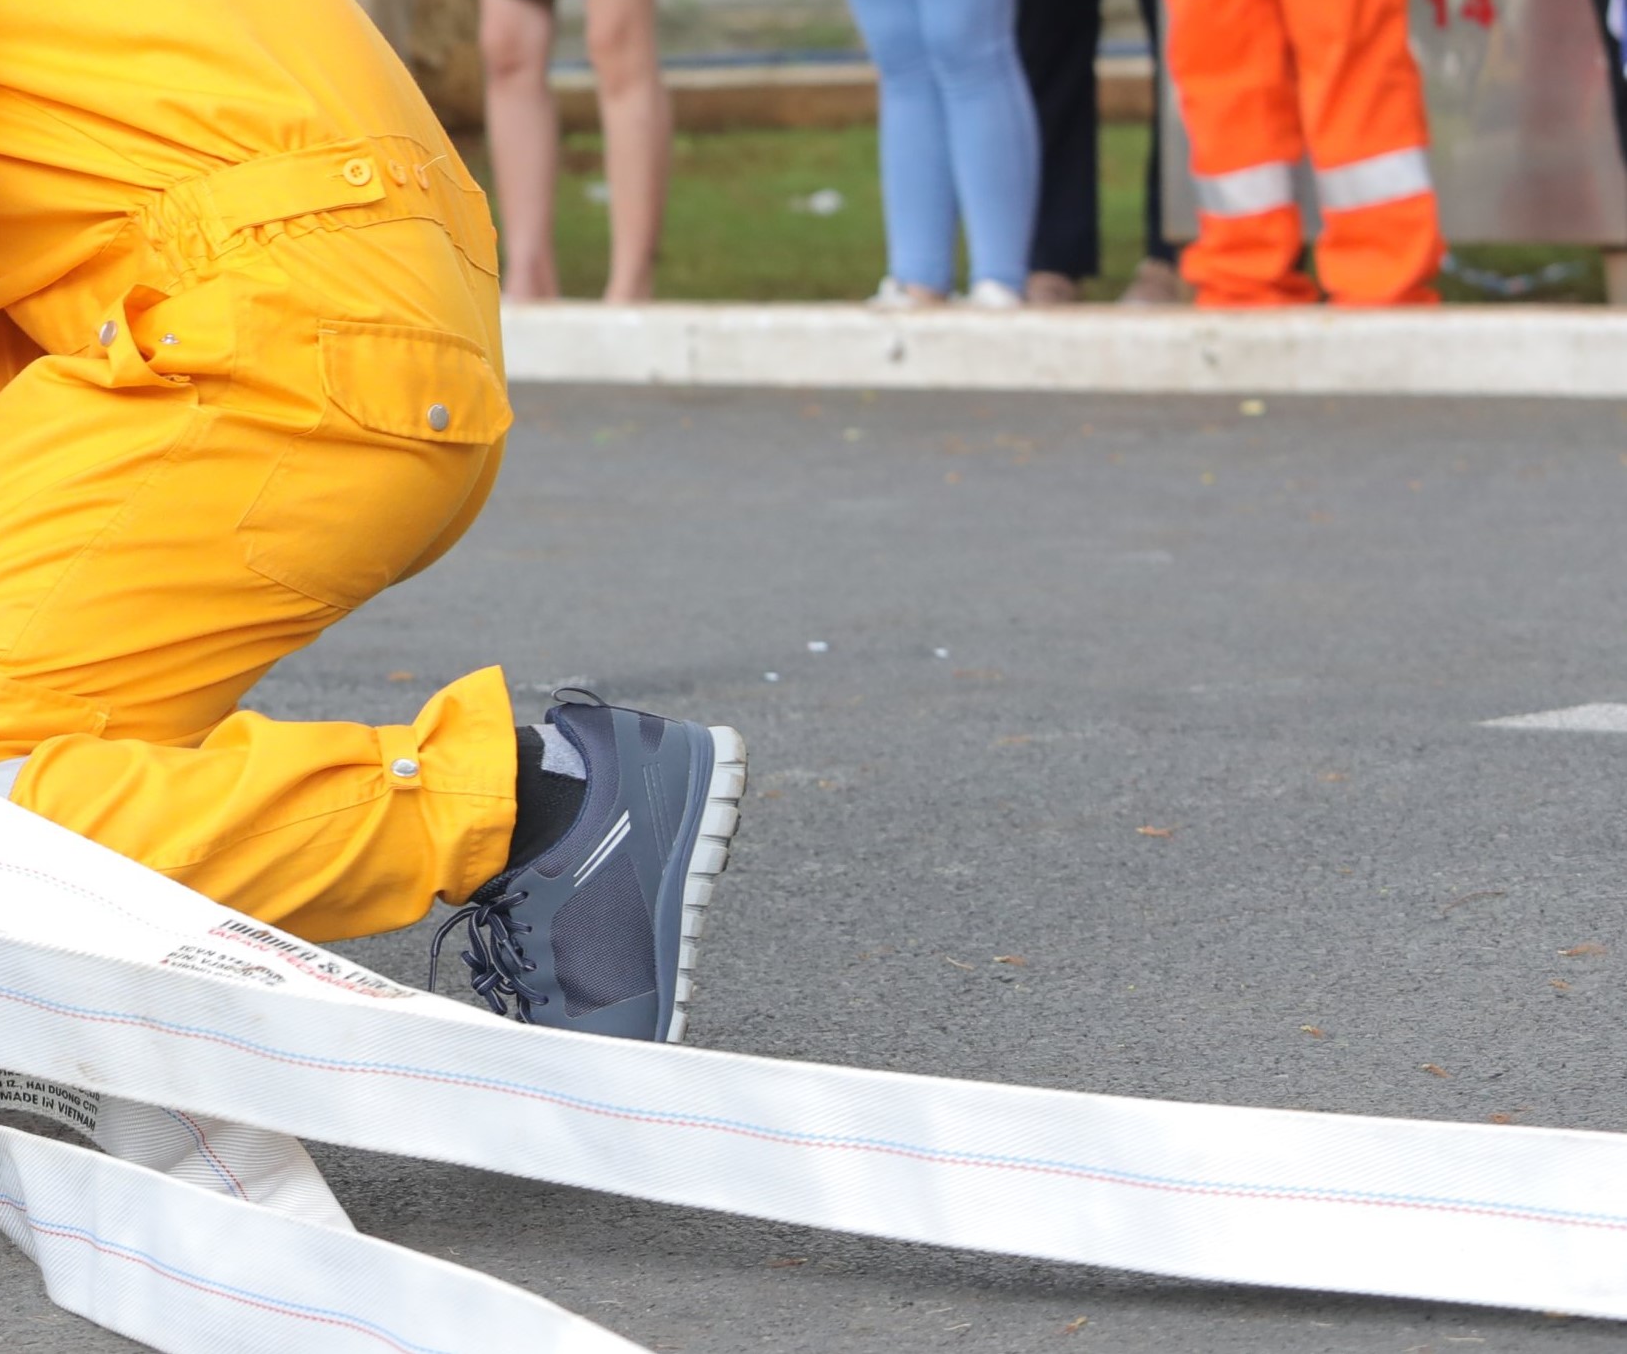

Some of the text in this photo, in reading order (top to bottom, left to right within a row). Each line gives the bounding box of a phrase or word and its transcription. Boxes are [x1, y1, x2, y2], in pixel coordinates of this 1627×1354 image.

[26, 1080, 46, 1093] HAI
[48, 1084, 81, 1106] DUONG
[0, 1090, 96, 1132] MADE IN VIETNAM
